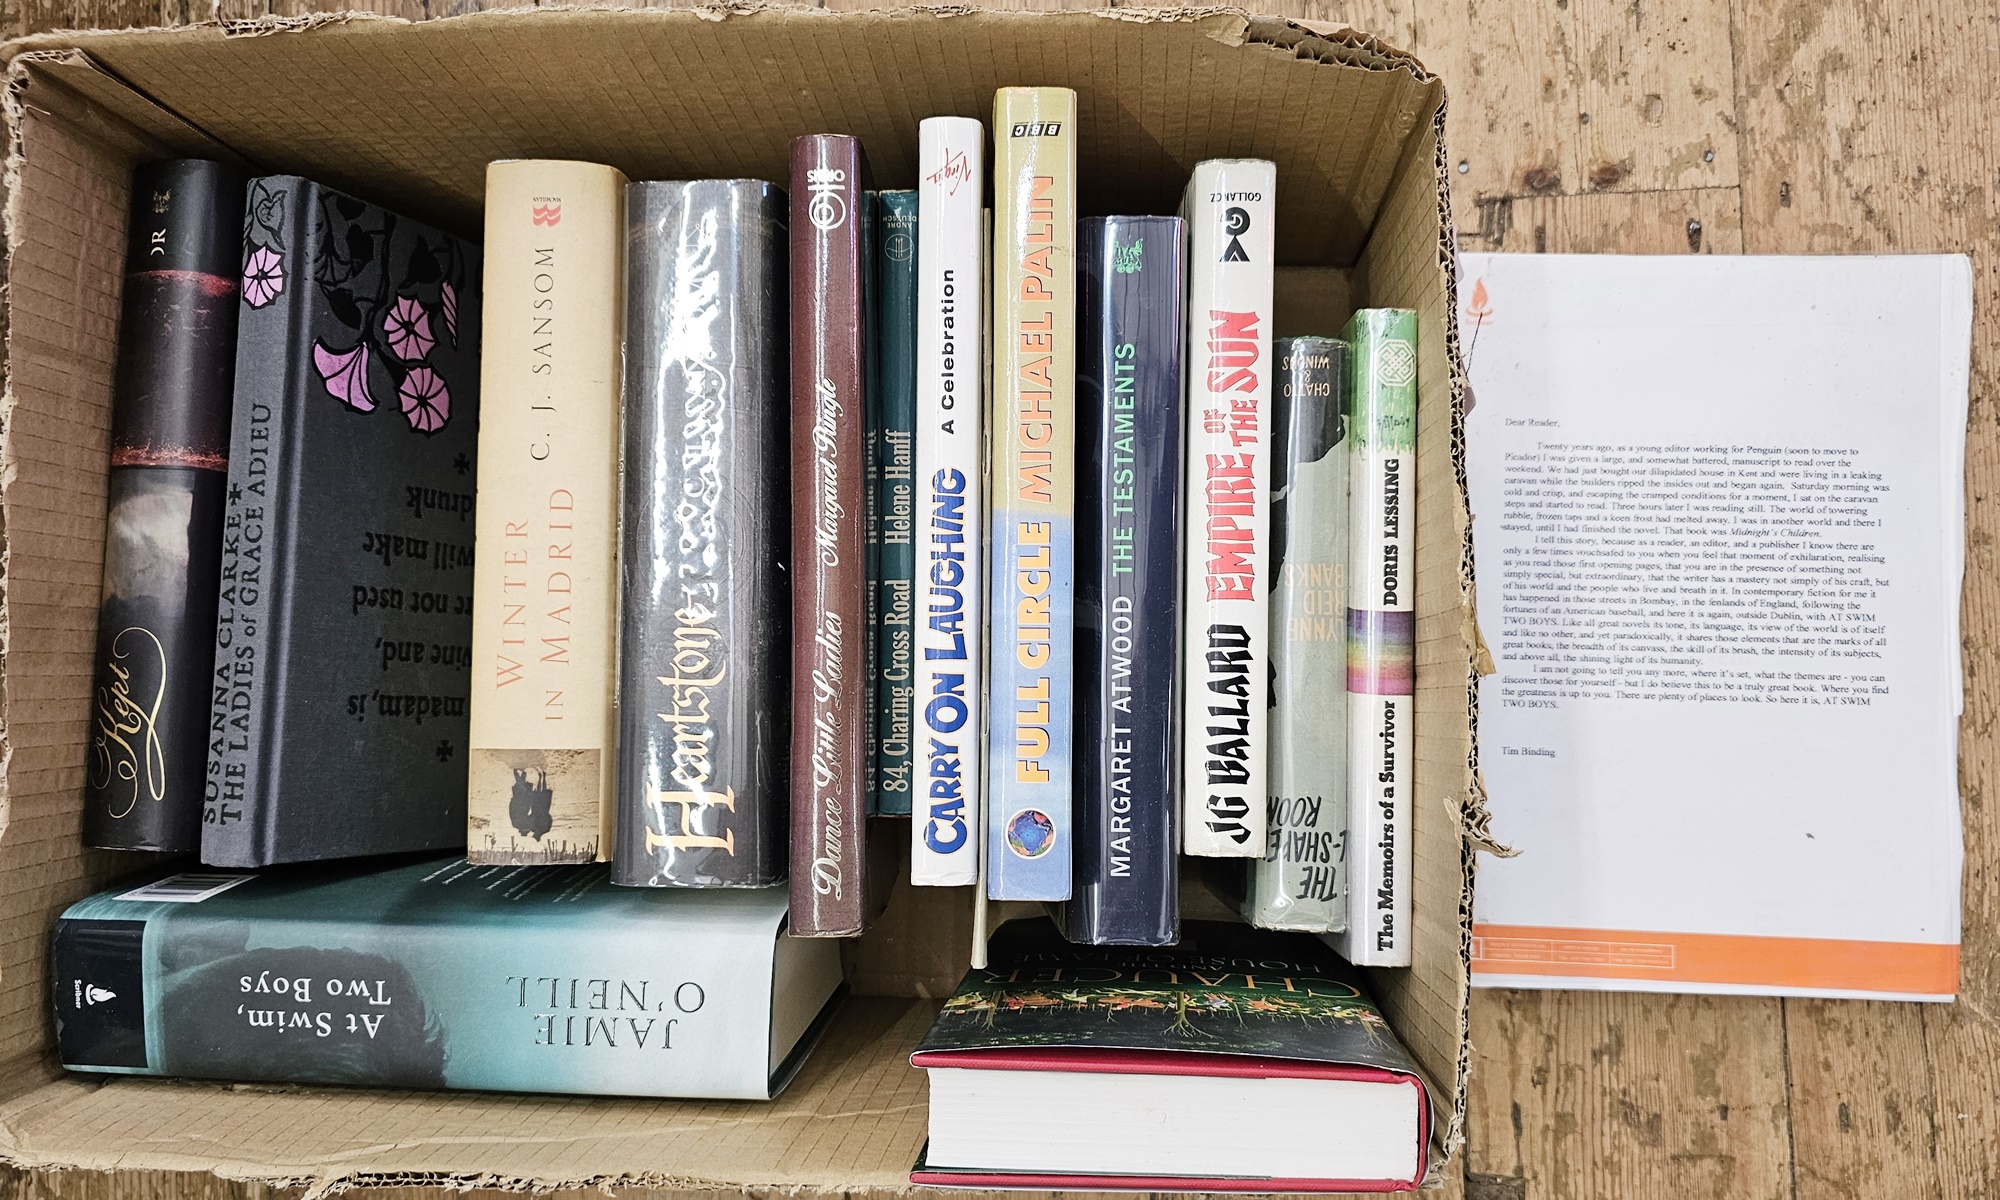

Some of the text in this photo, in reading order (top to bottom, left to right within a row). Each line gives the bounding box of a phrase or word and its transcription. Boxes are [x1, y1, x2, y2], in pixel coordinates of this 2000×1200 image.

[1011, 121, 1062, 138] BBC
[926, 147, 972, 196] Virgin
[882, 215, 917, 223] DEUTSCH
[530, 247, 557, 461] C. J. SANSOM
[941, 269, 955, 435] A Celebration
[1281, 354, 1331, 371] WINDUS
[1283, 382, 1331, 397] CHATTO
[1505, 418, 1560, 429] Dear Reader,
[1203, 309, 1260, 602] EMPIRE OF THE SUN
[1537, 442, 1569, 452] Twenty
[1570, 445, 1594, 453] years
[1595, 445, 1614, 454] ago,
[1635, 446, 1662, 454] young
[1664, 444, 1691, 453] editor
[1692, 444, 1729, 455] working
[1731, 445, 1744, 453] for
[1746, 445, 1783, 456] Penguin
[1784, 446, 1810, 456] (soon
[1811, 447, 1821, 455] to
[1849, 447, 1859, 455] to
[812, 376, 845, 567] Margaret Pringle
[1016, 176, 1053, 784] FULL CIRCLE MICHAEL PALIN
[406, 486, 473, 522] drunk
[1383, 458, 1400, 606] DORIS LESSING
[1502, 523, 1533, 533] stayed,
[1535, 523, 1555, 532] until
[1563, 524, 1579, 532] had
[1581, 525, 1616, 533] finished
[1618, 525, 1632, 534] the
[1633, 526, 1660, 534] novel.
[1662, 526, 1684, 534] That
[1686, 527, 1708, 535] book
[1728, 527, 1778, 538] Midnight's
[1780, 528, 1822, 537] Children.
[361, 531, 429, 566] make
[220, 402, 272, 825] THE LADIES of GRACE ADIEU
[352, 584, 404, 616] used
[411, 591, 449, 614] not
[496, 520, 529, 690] WINTER
[540, 488, 574, 721] IN MADRID
[883, 428, 914, 793] 84, Charing Cross Road Helene Hanff
[1110, 342, 1136, 878] MARGARET ATWOOD THE TESTAMENTS
[1303, 589, 1345, 616] REID
[1502, 605, 1538, 613] fortunes
[1538, 606, 1550, 614] of
[1562, 606, 1606, 615] American
[1608, 607, 1646, 618] baseball,
[1648, 608, 1665, 617] and
[1666, 609, 1687, 617] here
[1688, 609, 1695, 618] it
[1706, 612, 1734, 620] again,
[1735, 610, 1769, 619] outside
[1770, 611, 1804, 622] Dublin,
[1805, 612, 1827, 620] with
[1828, 613, 1844, 621] AT
[1845, 613, 1876, 622] SWIM
[1286, 617, 1345, 643] LYNNE
[203, 513, 243, 824] SUSANNA CLARKE
[374, 637, 425, 671] and,
[922, 467, 969, 855] CARRY ON LAUGHING
[1501, 652, 1704, 667] and above all, the shining light of its humanity.
[347, 690, 466, 725] madam, is
[1502, 699, 1559, 708] TWO BOYS.
[645, 605, 735, 857] Heartstone
[1205, 624, 1254, 846] JG BALLARD
[811, 610, 844, 902] Dance Little Ladies
[1500, 747, 1556, 758] Tim Binding
[1377, 700, 1395, 952] The Memoirs of a Survivor
[1265, 828, 1350, 864] L-SHAPE
[1295, 865, 1337, 902] THE
[1187, 955, 1321, 974] HOUSE
[73, 978, 82, 1010] Scribner
[240, 970, 392, 1005] Two Boys
[505, 975, 706, 1014] O'NEILL
[980, 967, 1361, 1000] CHAUCER
[237, 1004, 385, 1039] At Swim,
[533, 1014, 679, 1049] JAMIE
